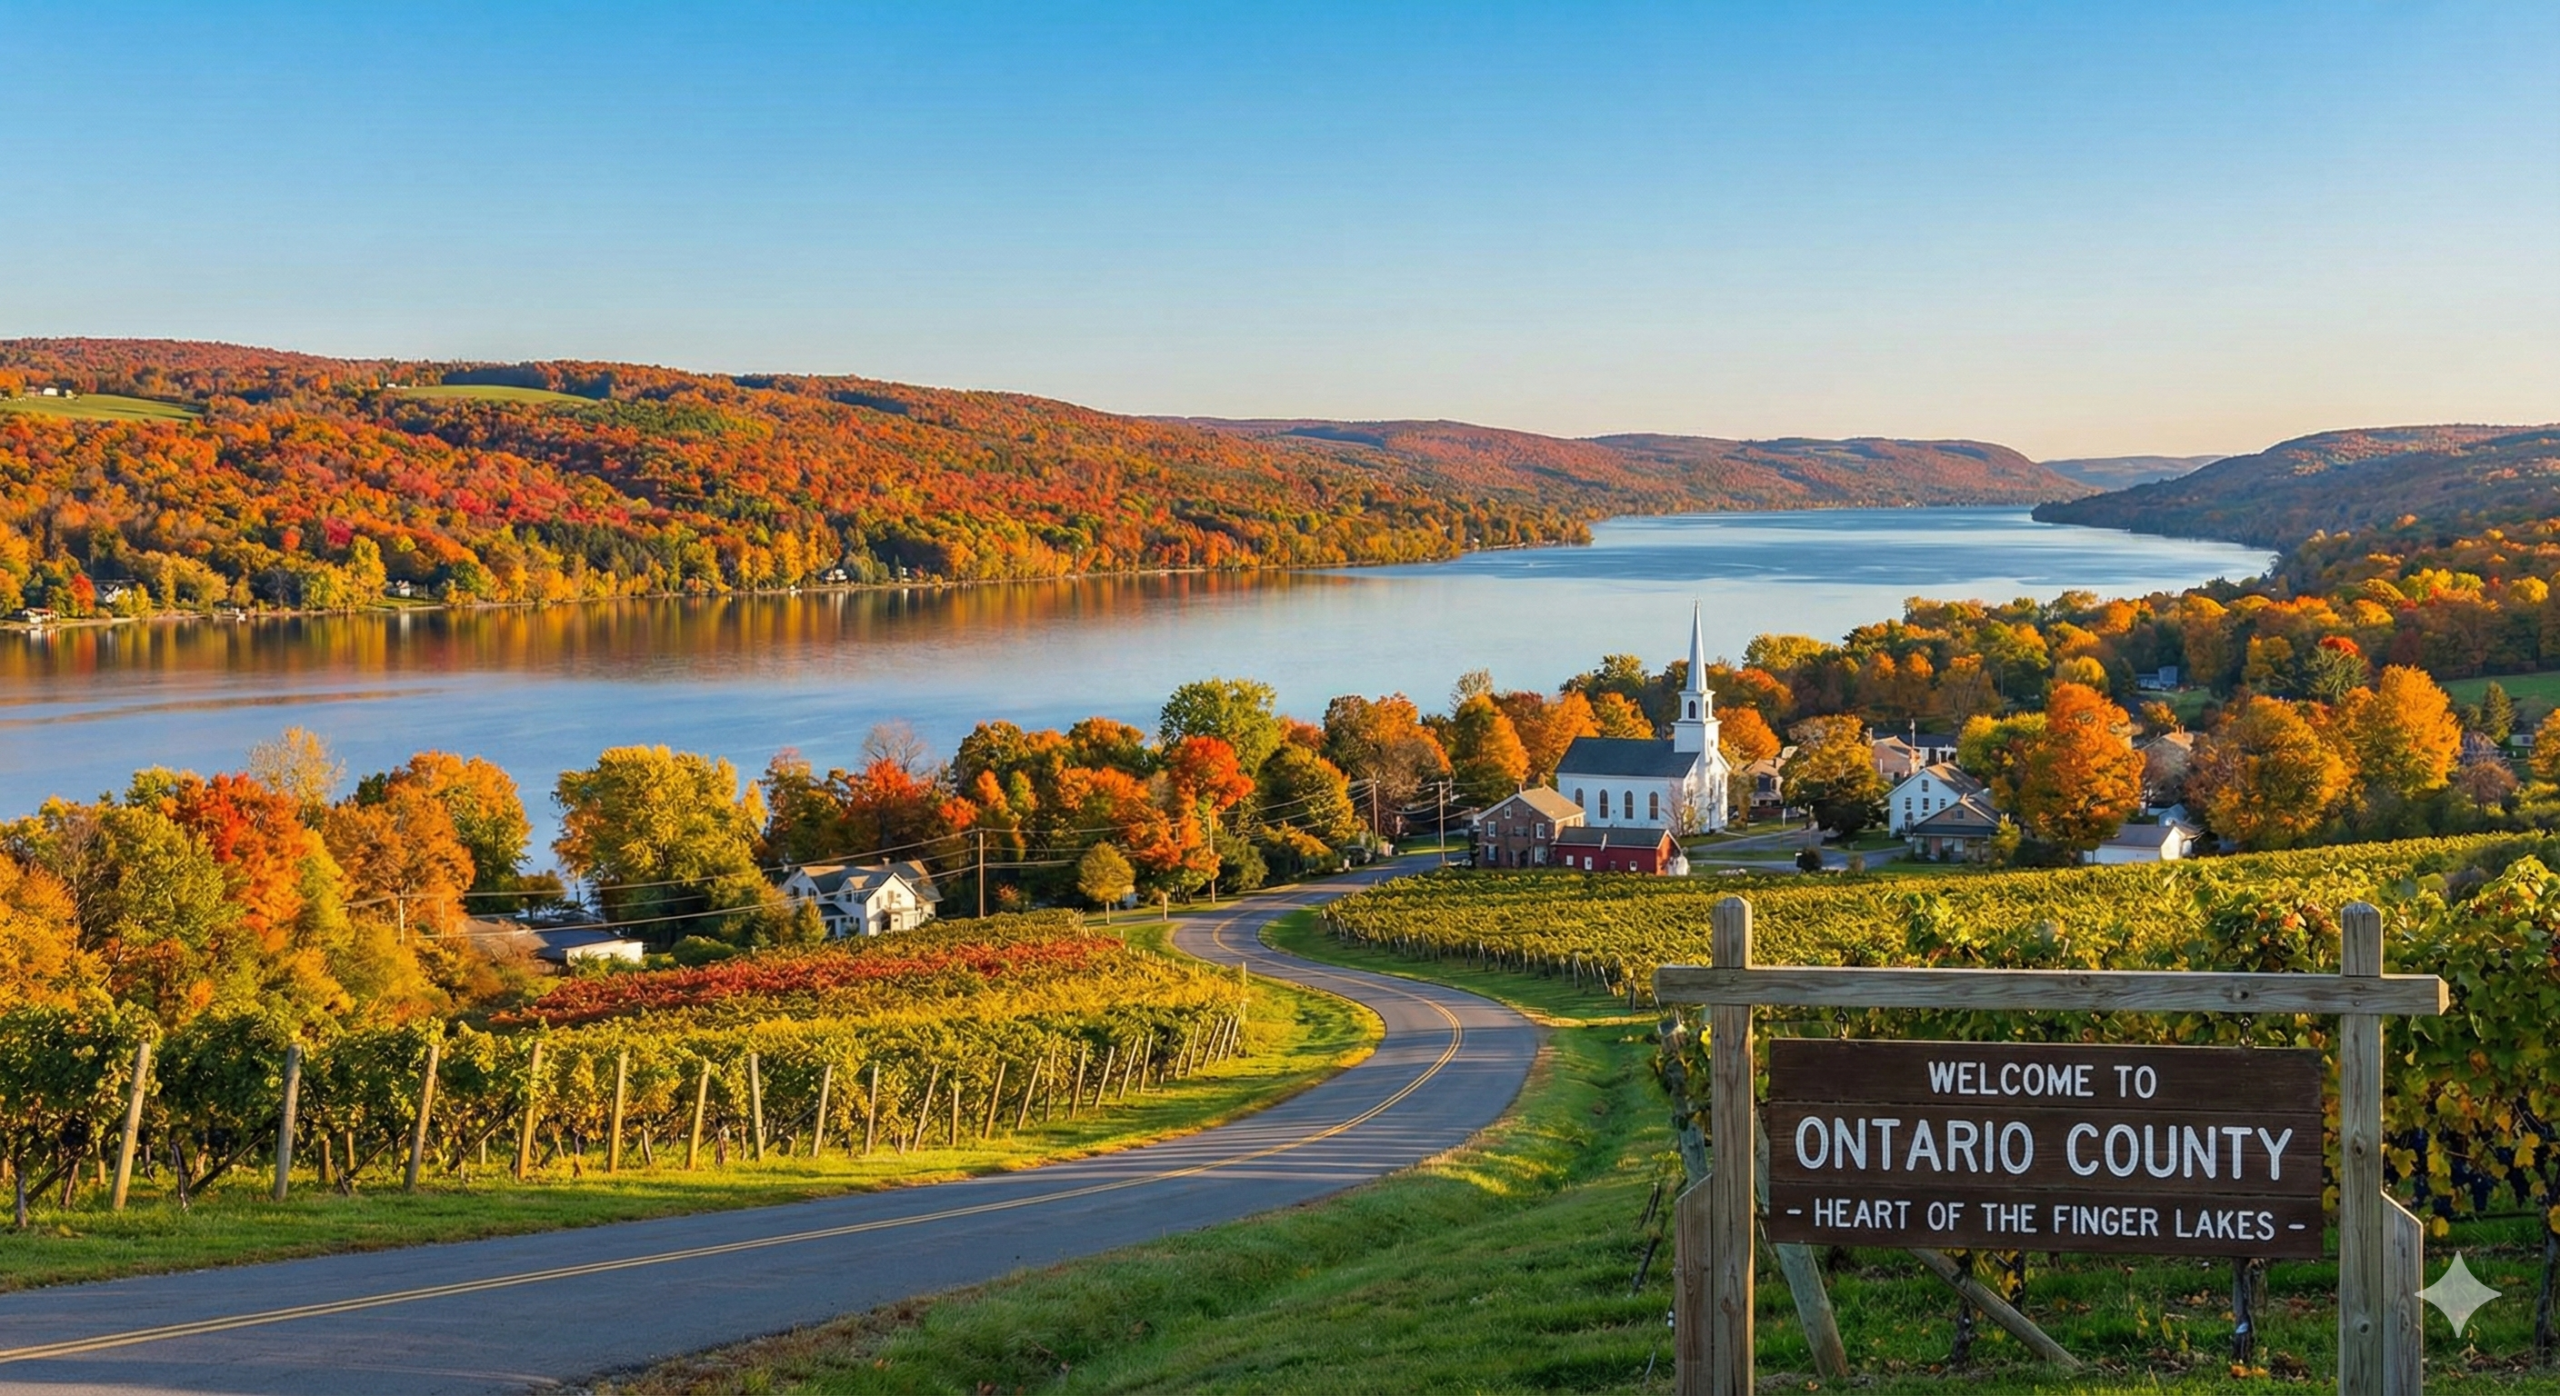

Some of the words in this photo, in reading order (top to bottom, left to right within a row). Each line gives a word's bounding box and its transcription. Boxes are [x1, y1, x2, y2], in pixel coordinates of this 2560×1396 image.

[1928, 1061, 2094, 1097] WELCOME
[2113, 1065, 2157, 1099] TO
[1795, 1116, 2034, 1175] ONTARIO
[2066, 1122, 2293, 1181] COUNTY
[1815, 1198, 1911, 1230] HEART
[1927, 1201, 1965, 1231] OF
[1980, 1203, 2037, 1233] THE
[2054, 1205, 2159, 1237] FINGER
[2176, 1208, 2275, 1241] LAKES
